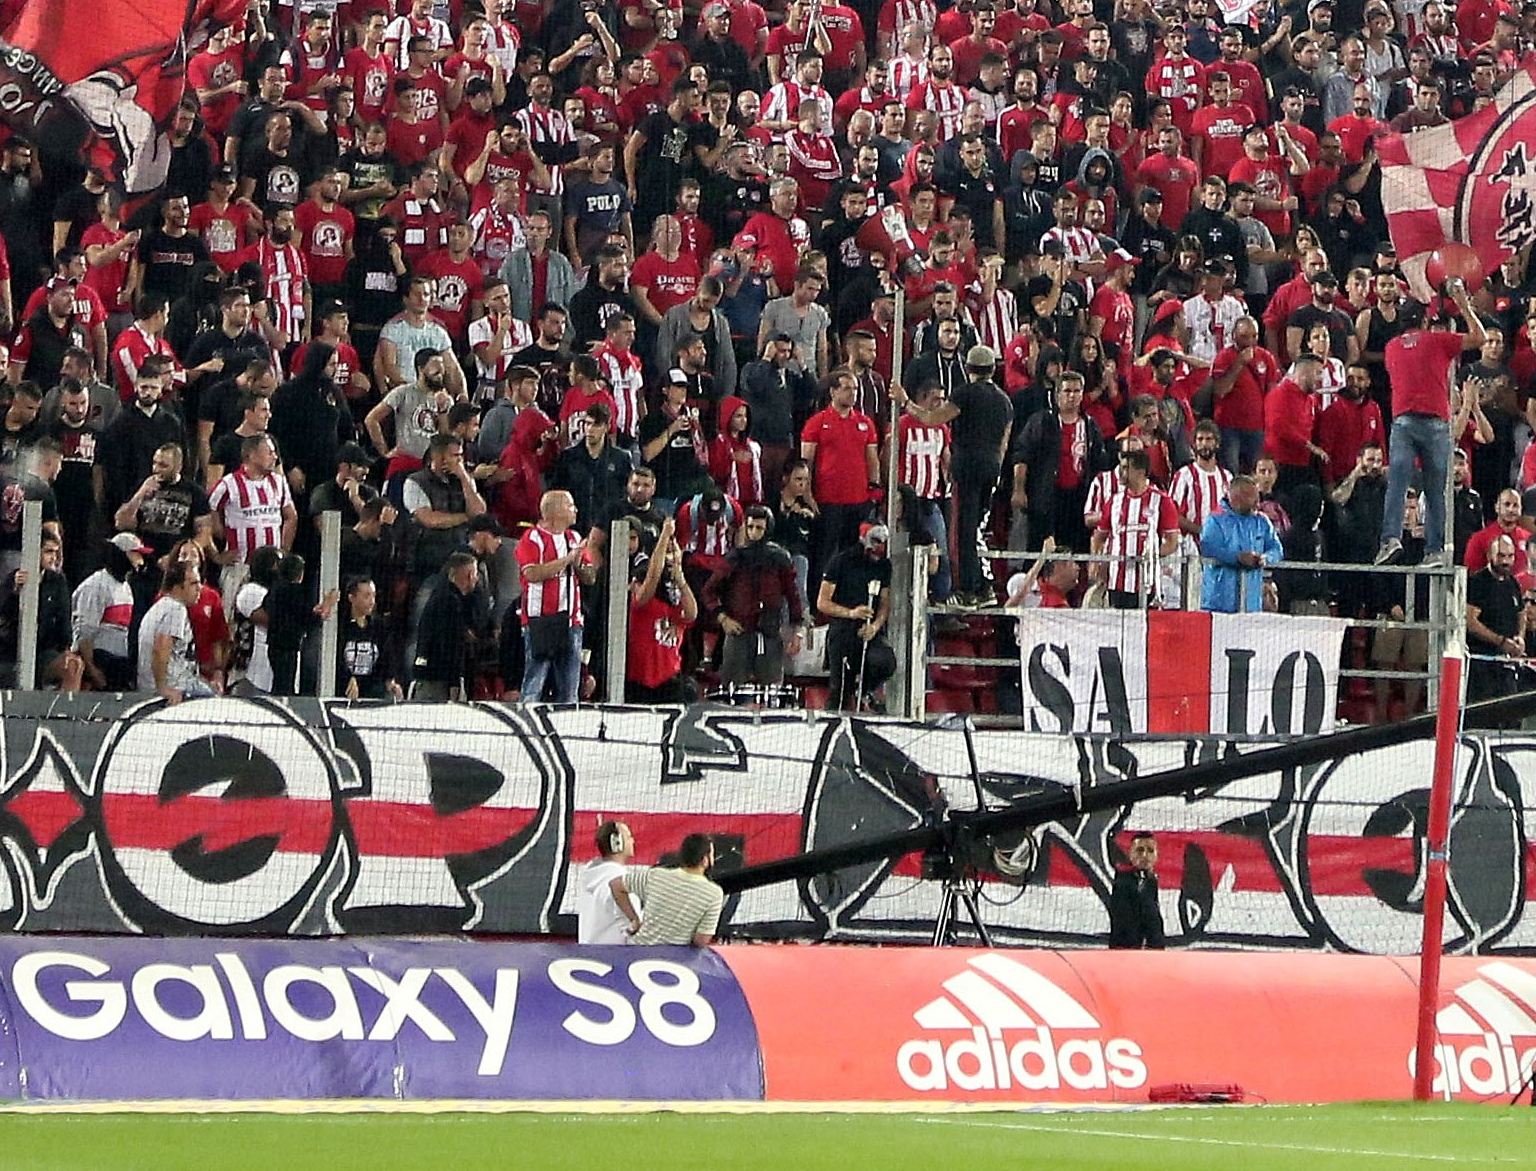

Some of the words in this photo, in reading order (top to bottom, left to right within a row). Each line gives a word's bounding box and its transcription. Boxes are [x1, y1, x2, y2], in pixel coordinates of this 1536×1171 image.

[10, 950, 519, 1077] Galaxy
[548, 958, 717, 1047] S8
[895, 1024, 1149, 1092] adidas
